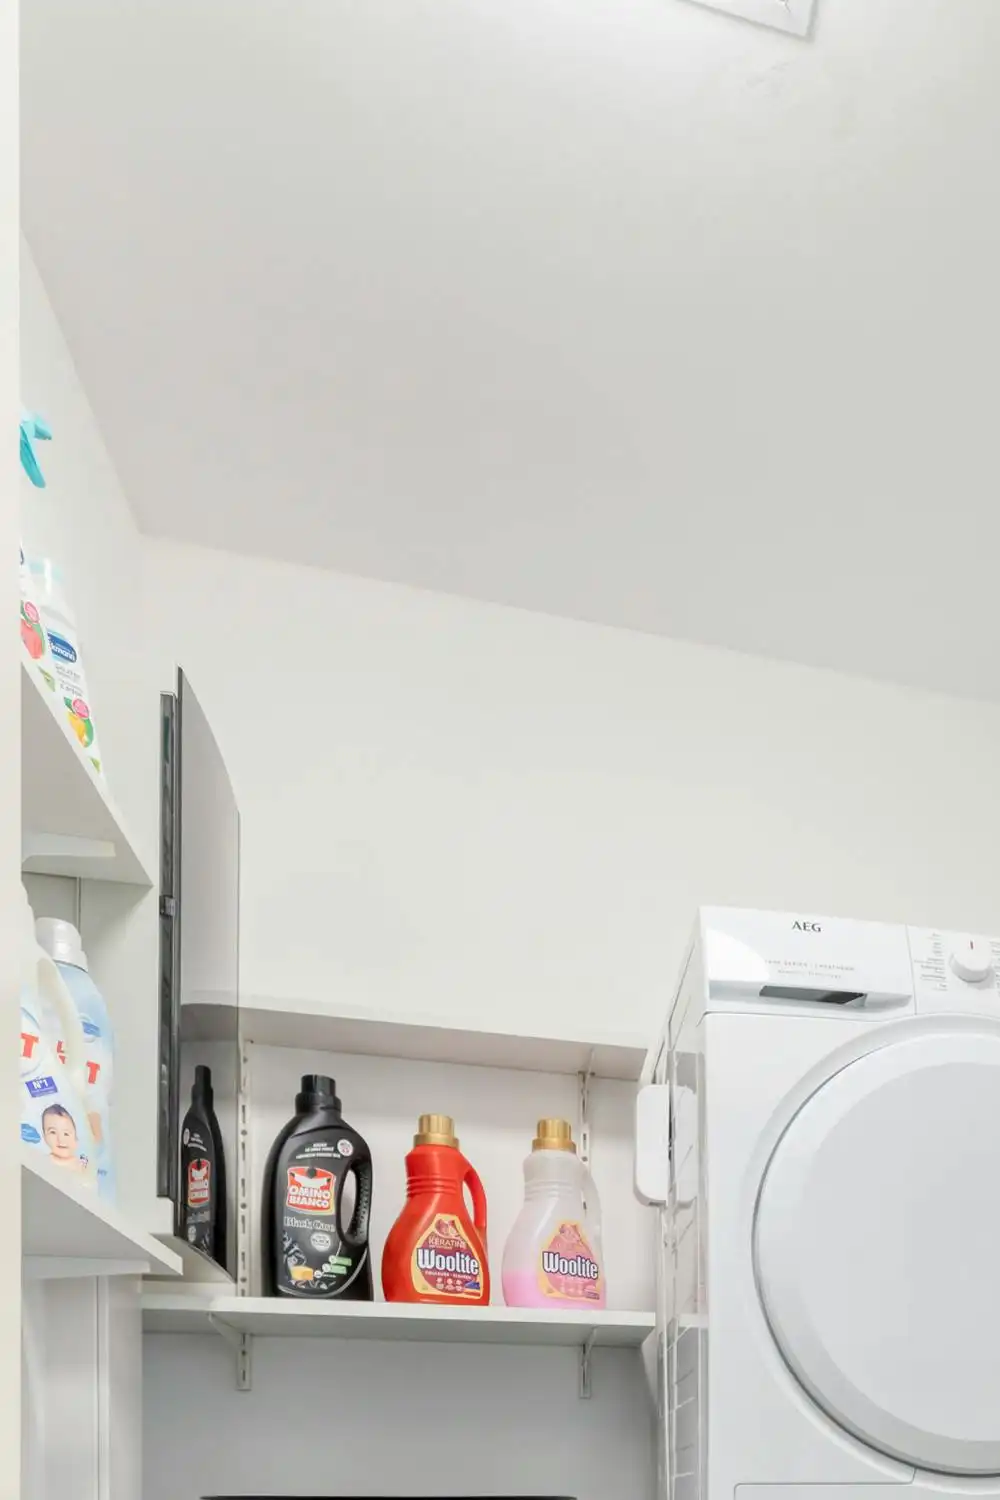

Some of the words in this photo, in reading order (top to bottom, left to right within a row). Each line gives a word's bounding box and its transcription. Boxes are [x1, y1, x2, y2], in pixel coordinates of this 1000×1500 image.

[792, 921, 822, 932] AEG
[288, 1185, 331, 1200] OMINO
[289, 1195, 330, 1209] BIANCO
[418, 1248, 479, 1275] Woolite
[543, 1251, 598, 1280] Woolite
